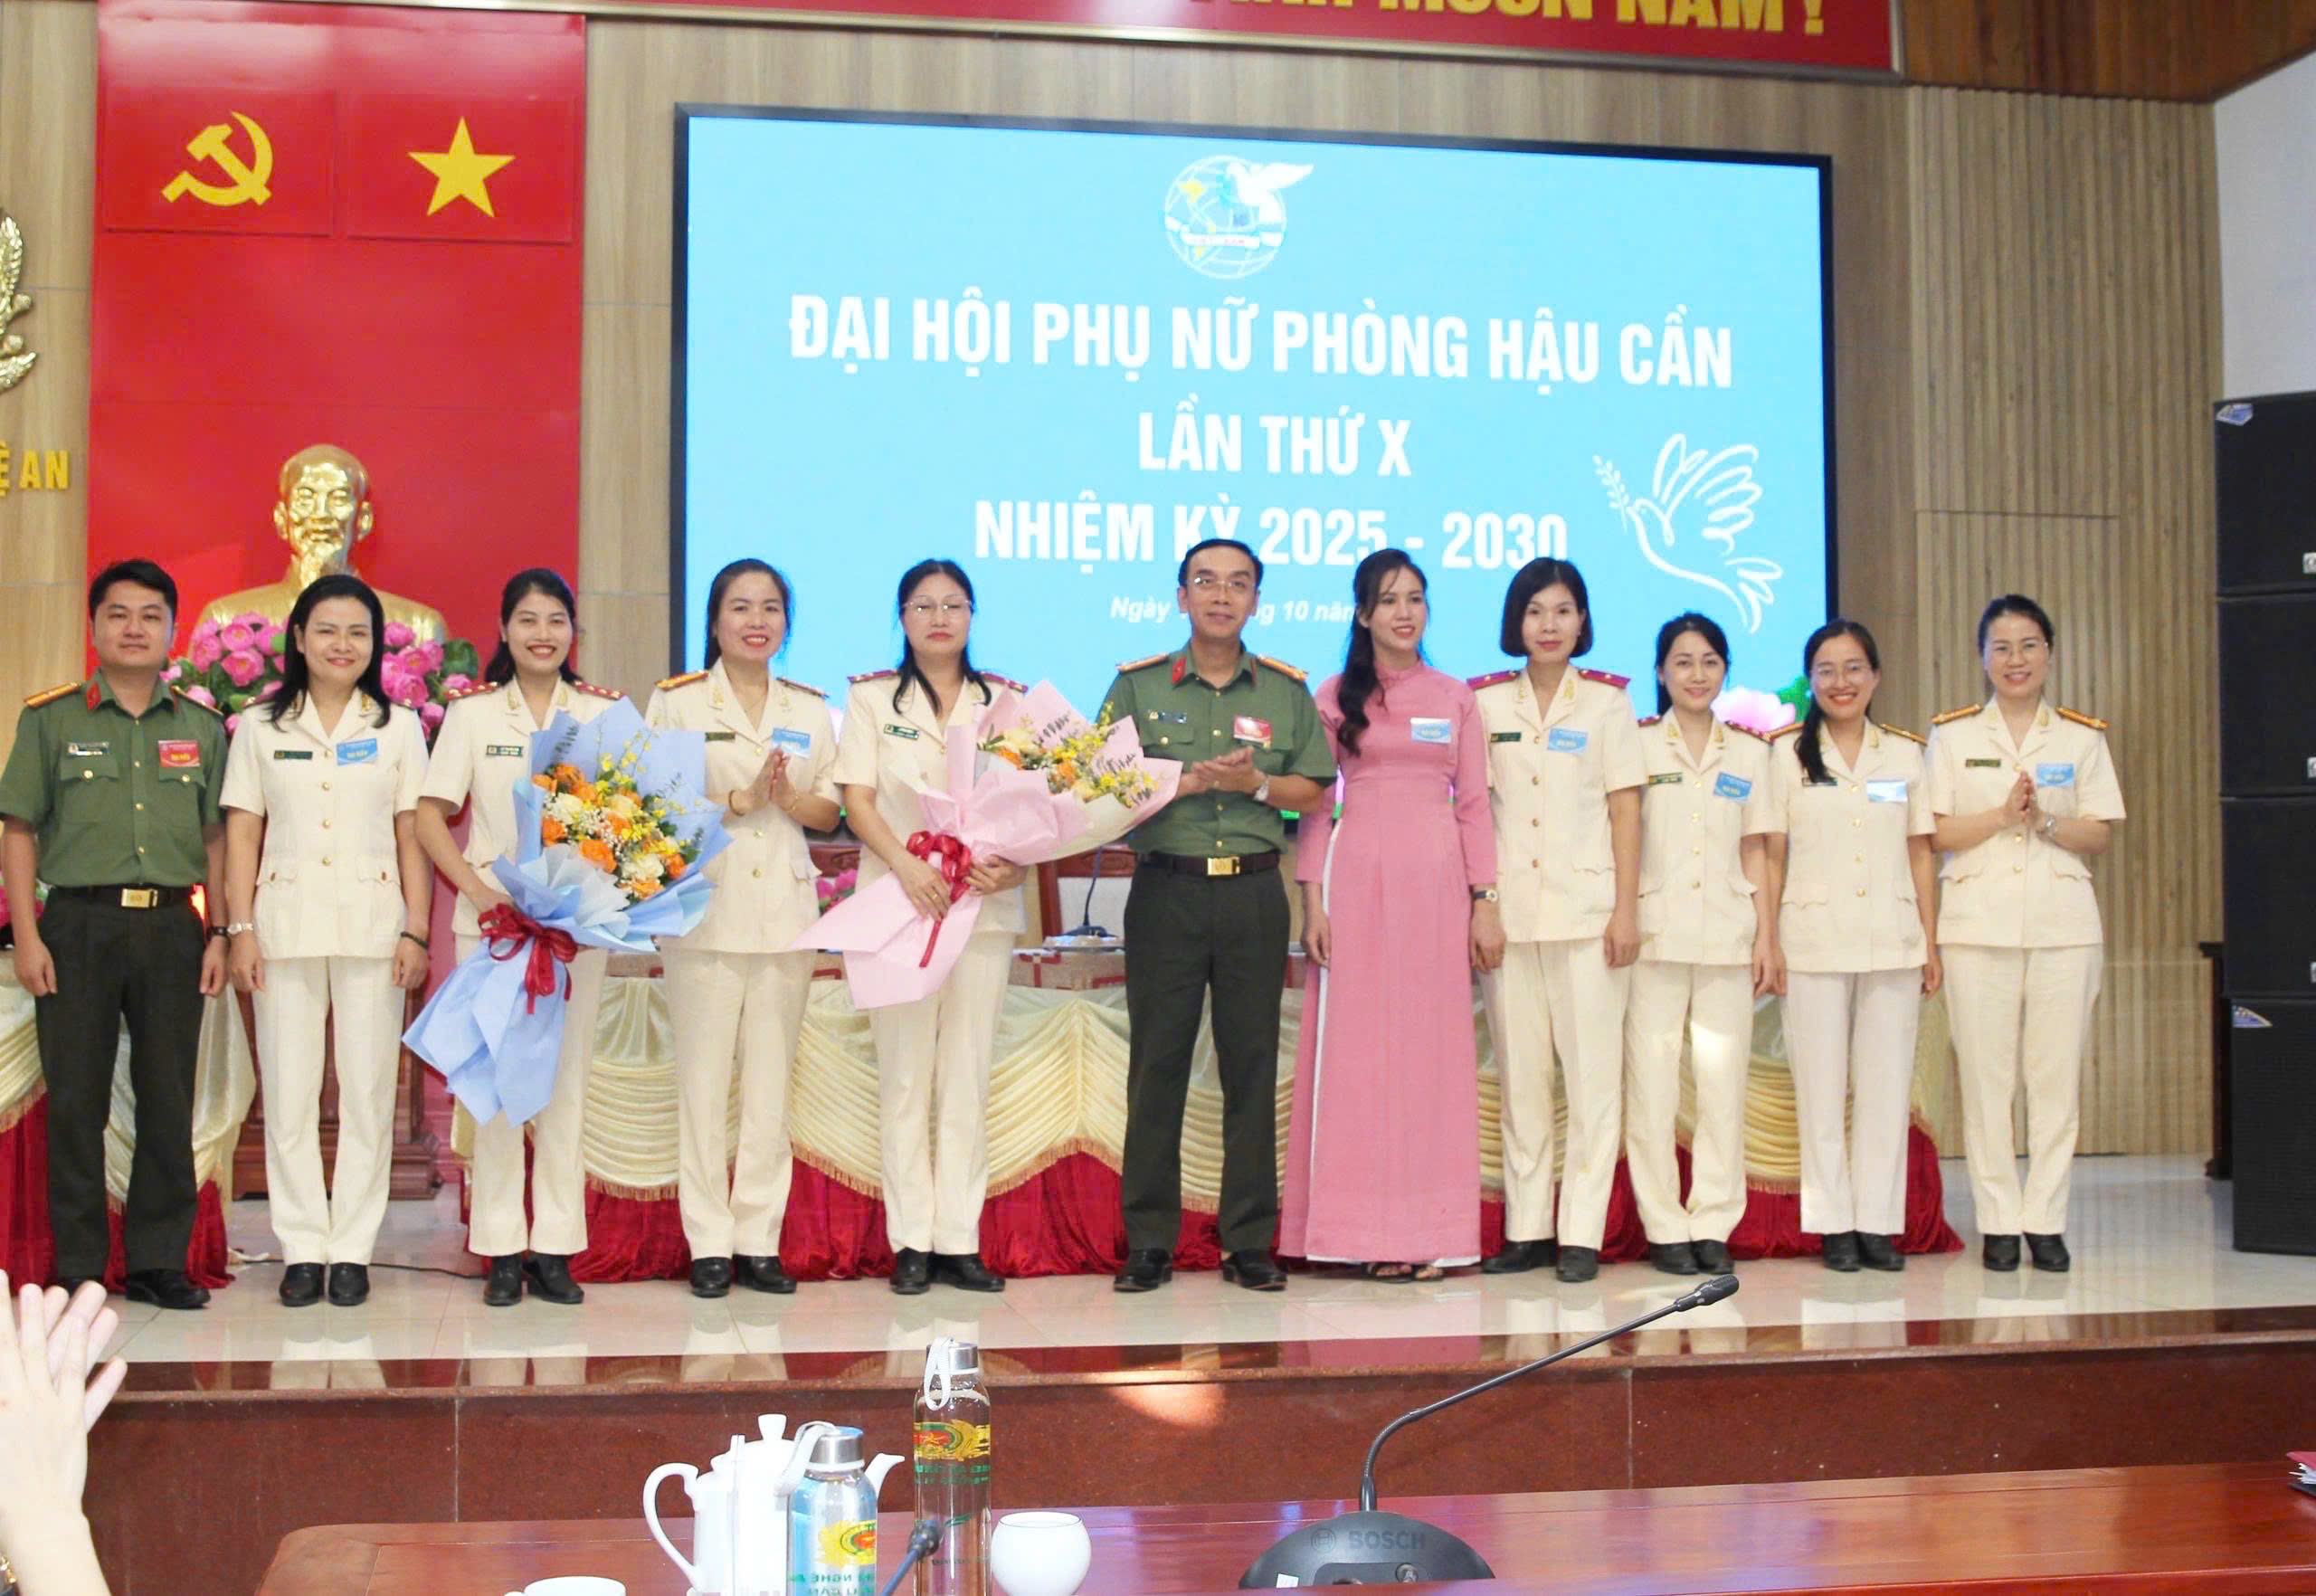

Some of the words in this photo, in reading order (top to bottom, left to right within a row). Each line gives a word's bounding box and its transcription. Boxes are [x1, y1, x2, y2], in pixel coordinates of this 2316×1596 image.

[789, 294, 890, 374] ĐẠI
[913, 286, 1011, 377] HỘI
[1033, 302, 1150, 382] PHỤ
[1172, 297, 1259, 372] NỮ
[1273, 297, 1468, 378] PHÒNG
[1489, 306, 1599, 395] HẬU
[1620, 304, 1732, 388] CẦN
[1139, 392, 1242, 471] LẦN
[1259, 405, 1365, 476] THỨ
[1377, 419, 1412, 477] X
[19, 449, 70, 490] AN
[975, 489, 1154, 574] NHIỆM
[1173, 492, 1241, 563] KỲ
[1258, 507, 1389, 565] 2025
[1404, 537, 1425, 550] -
[1442, 511, 1568, 570] 2030
[1110, 595, 1172, 622] Ngày
[1283, 601, 1310, 622] 10
[1348, 1530, 1426, 1550] BOSCH
